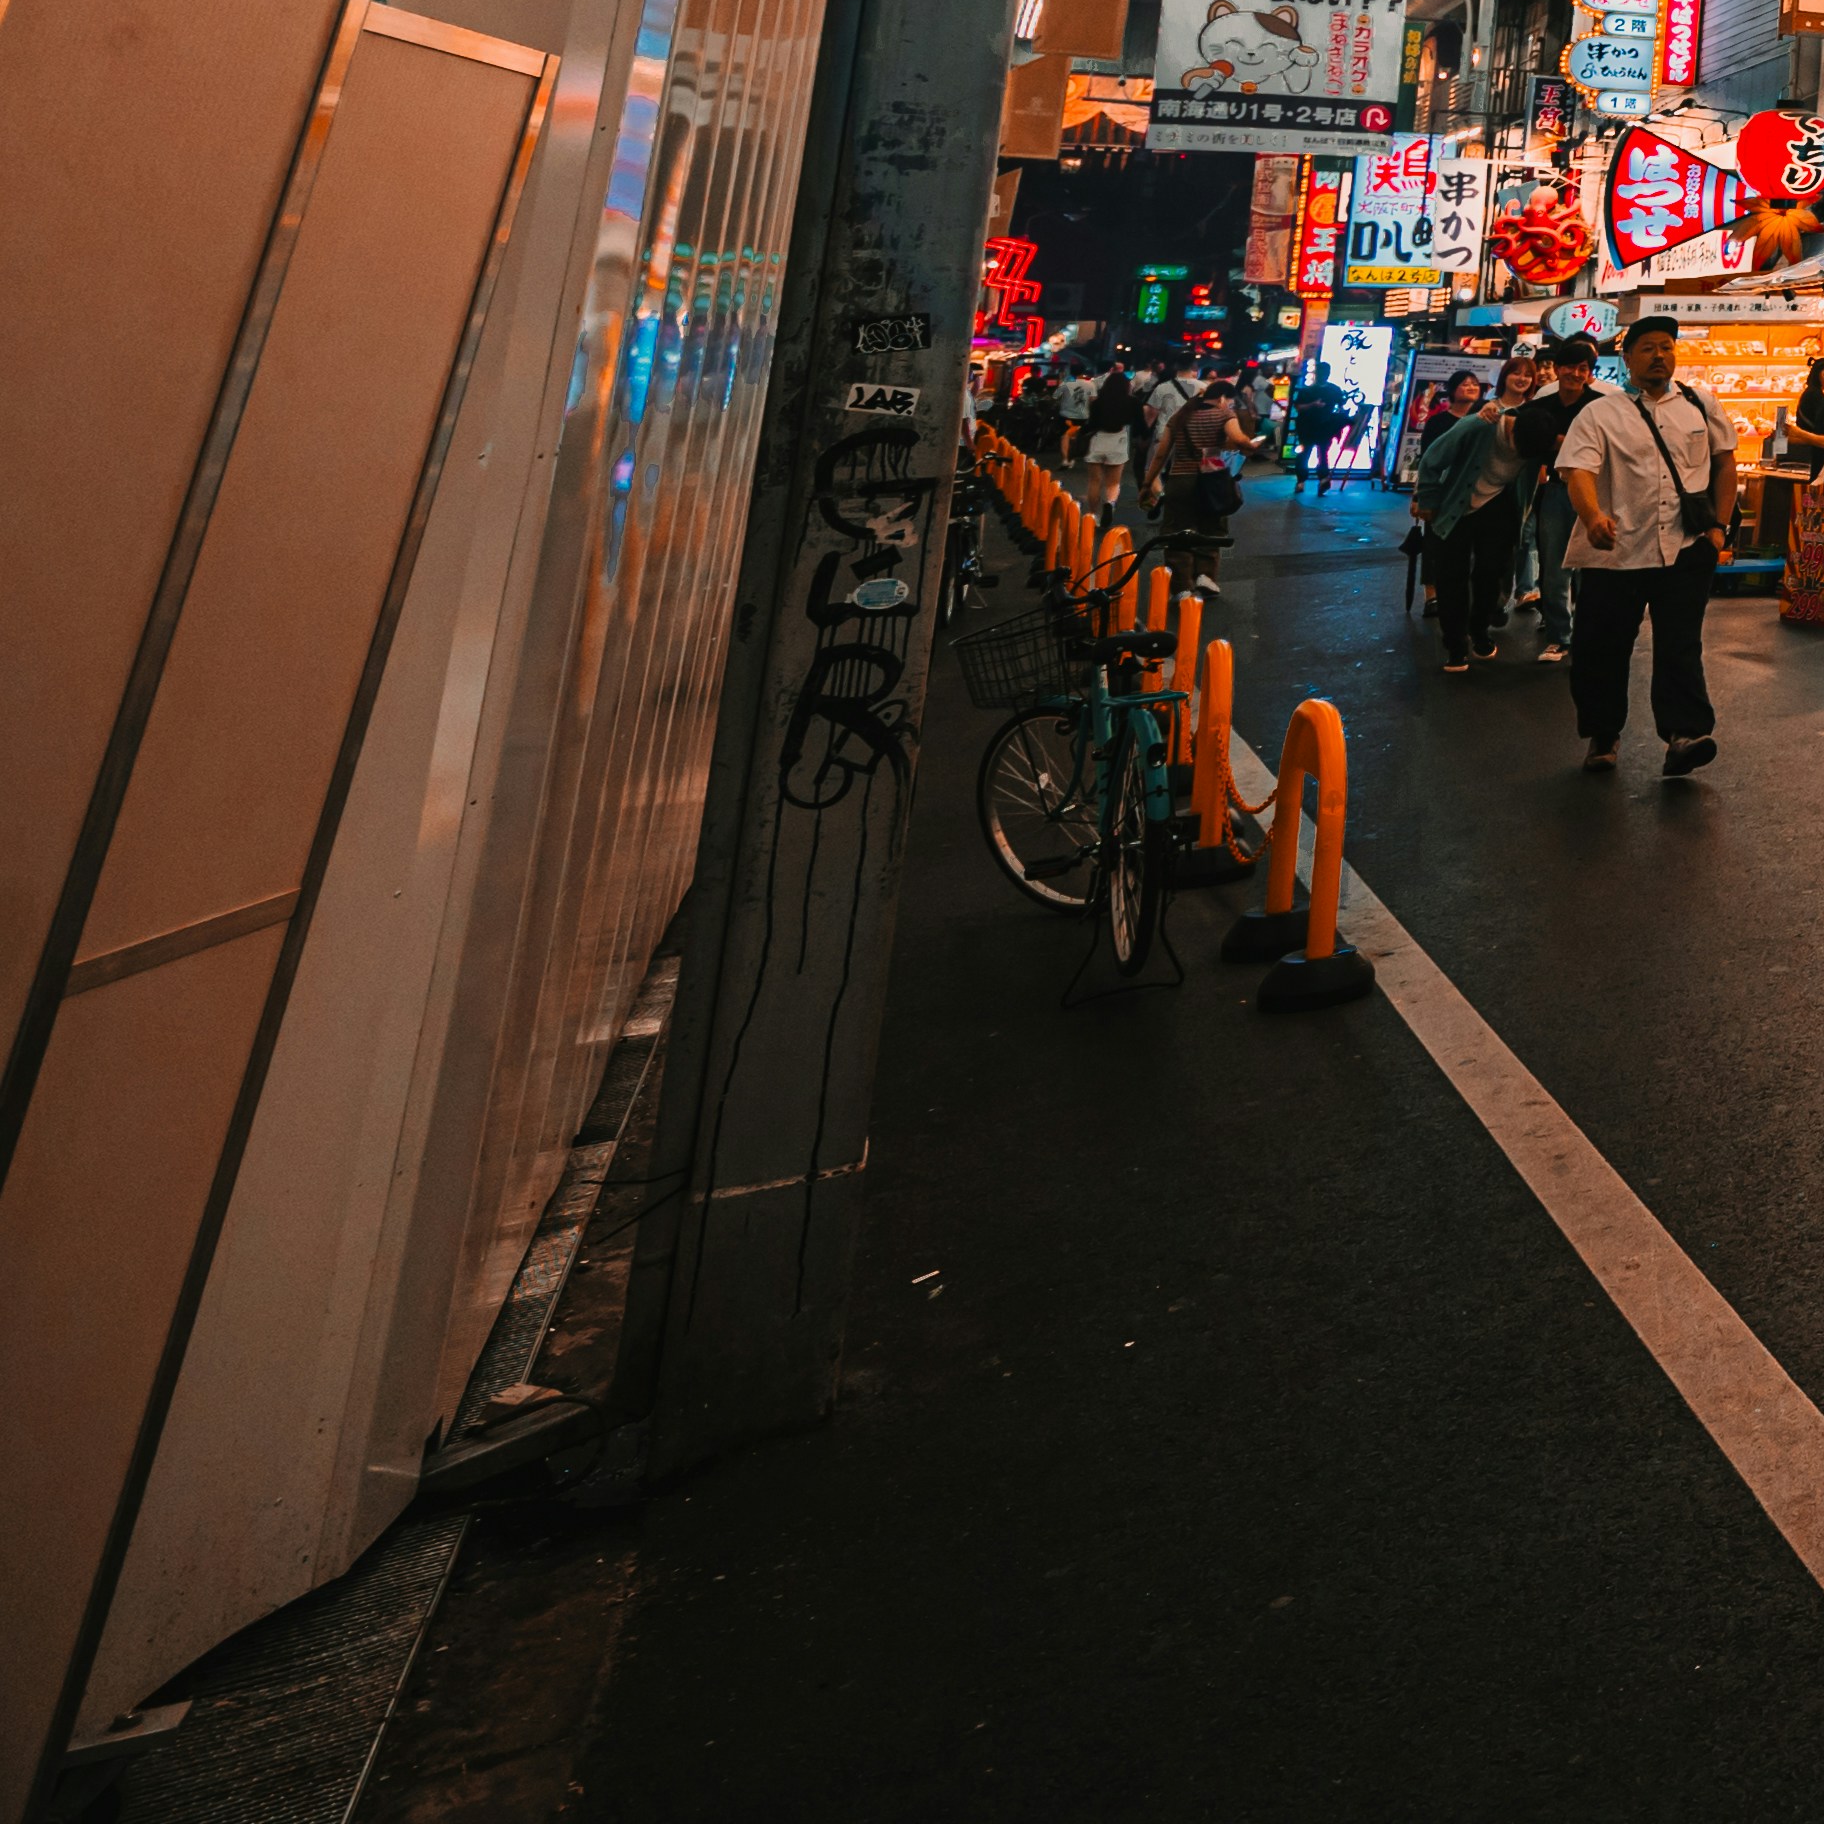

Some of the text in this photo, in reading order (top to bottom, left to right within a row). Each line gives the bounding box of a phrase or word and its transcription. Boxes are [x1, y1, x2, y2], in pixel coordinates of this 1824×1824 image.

[1614, 18, 1647, 33] 2階
[1587, 42, 1639, 61] 串かつ
[1157, 97, 1359, 127] 南海通り1号・2号店
[1616, 144, 1685, 249] はつせ
[1436, 170, 1480, 268] 串かつ
